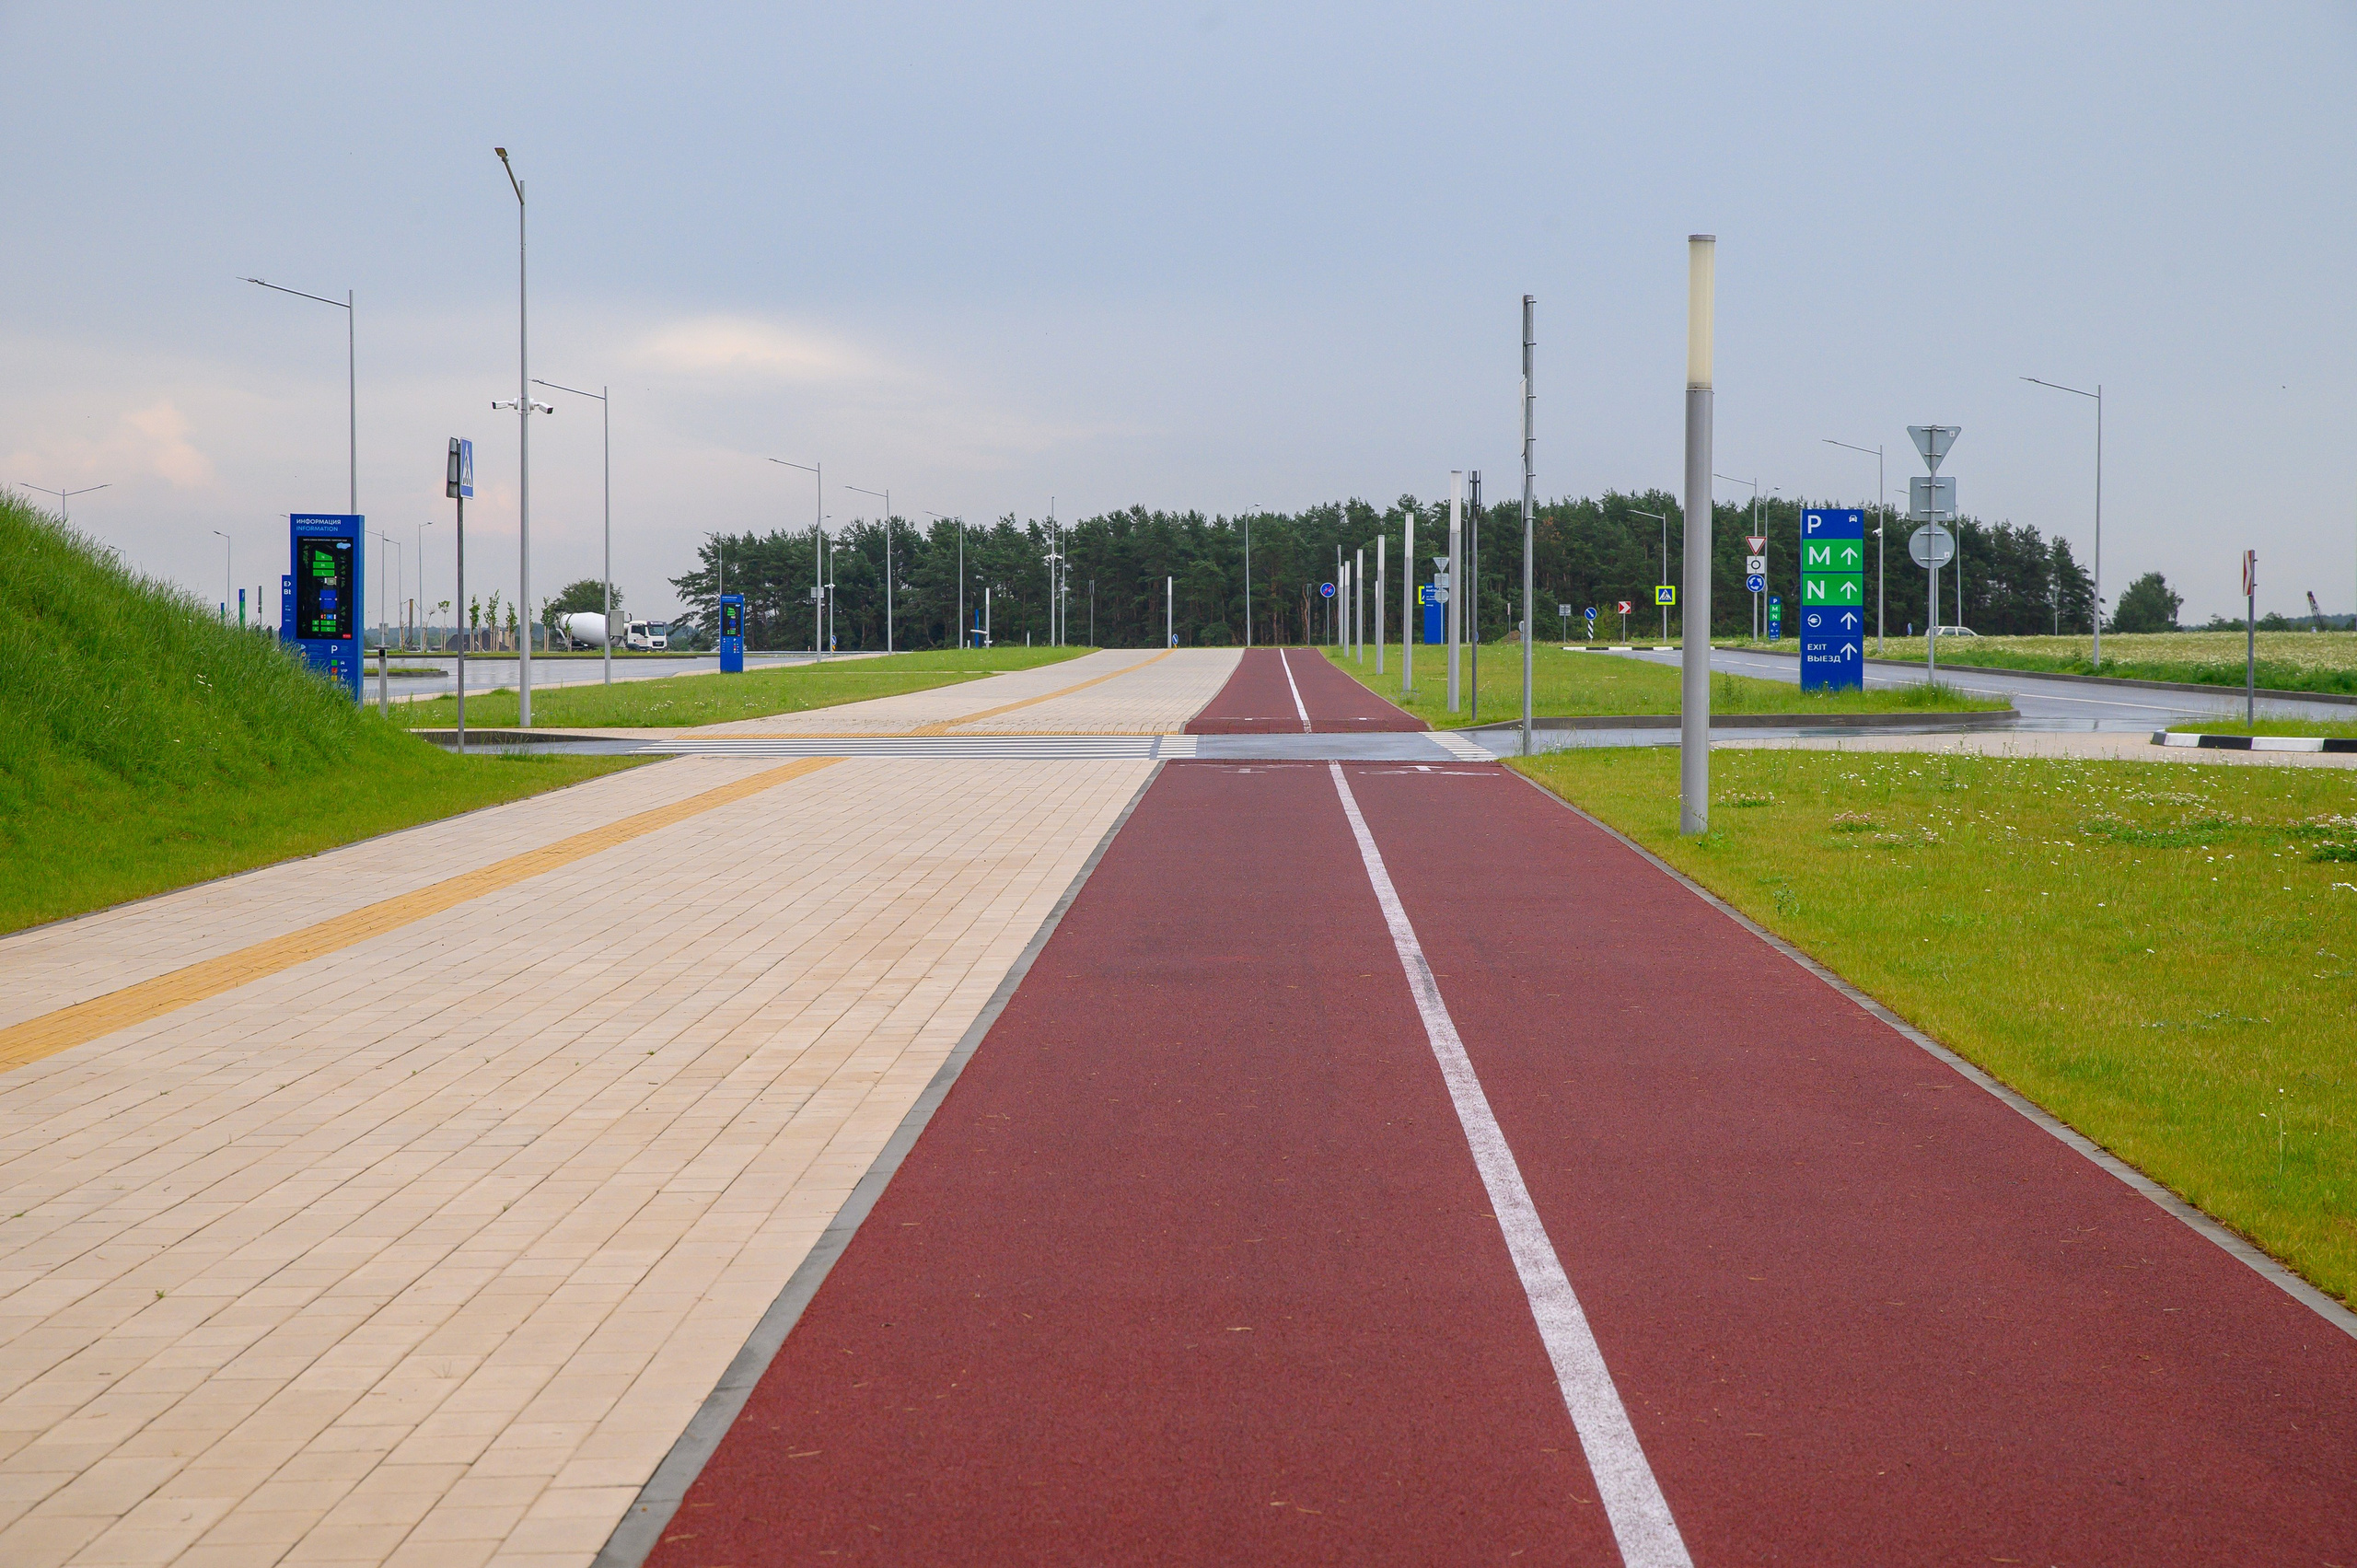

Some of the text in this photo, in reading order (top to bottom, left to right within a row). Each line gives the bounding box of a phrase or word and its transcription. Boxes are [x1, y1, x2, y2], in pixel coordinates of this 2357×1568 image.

[1807, 515, 1822, 534] P
[1808, 546, 1830, 565] M
[1807, 580, 1825, 599] N
[331, 645, 338, 654] P
[1807, 655, 1841, 663] ВЫЕЗД
